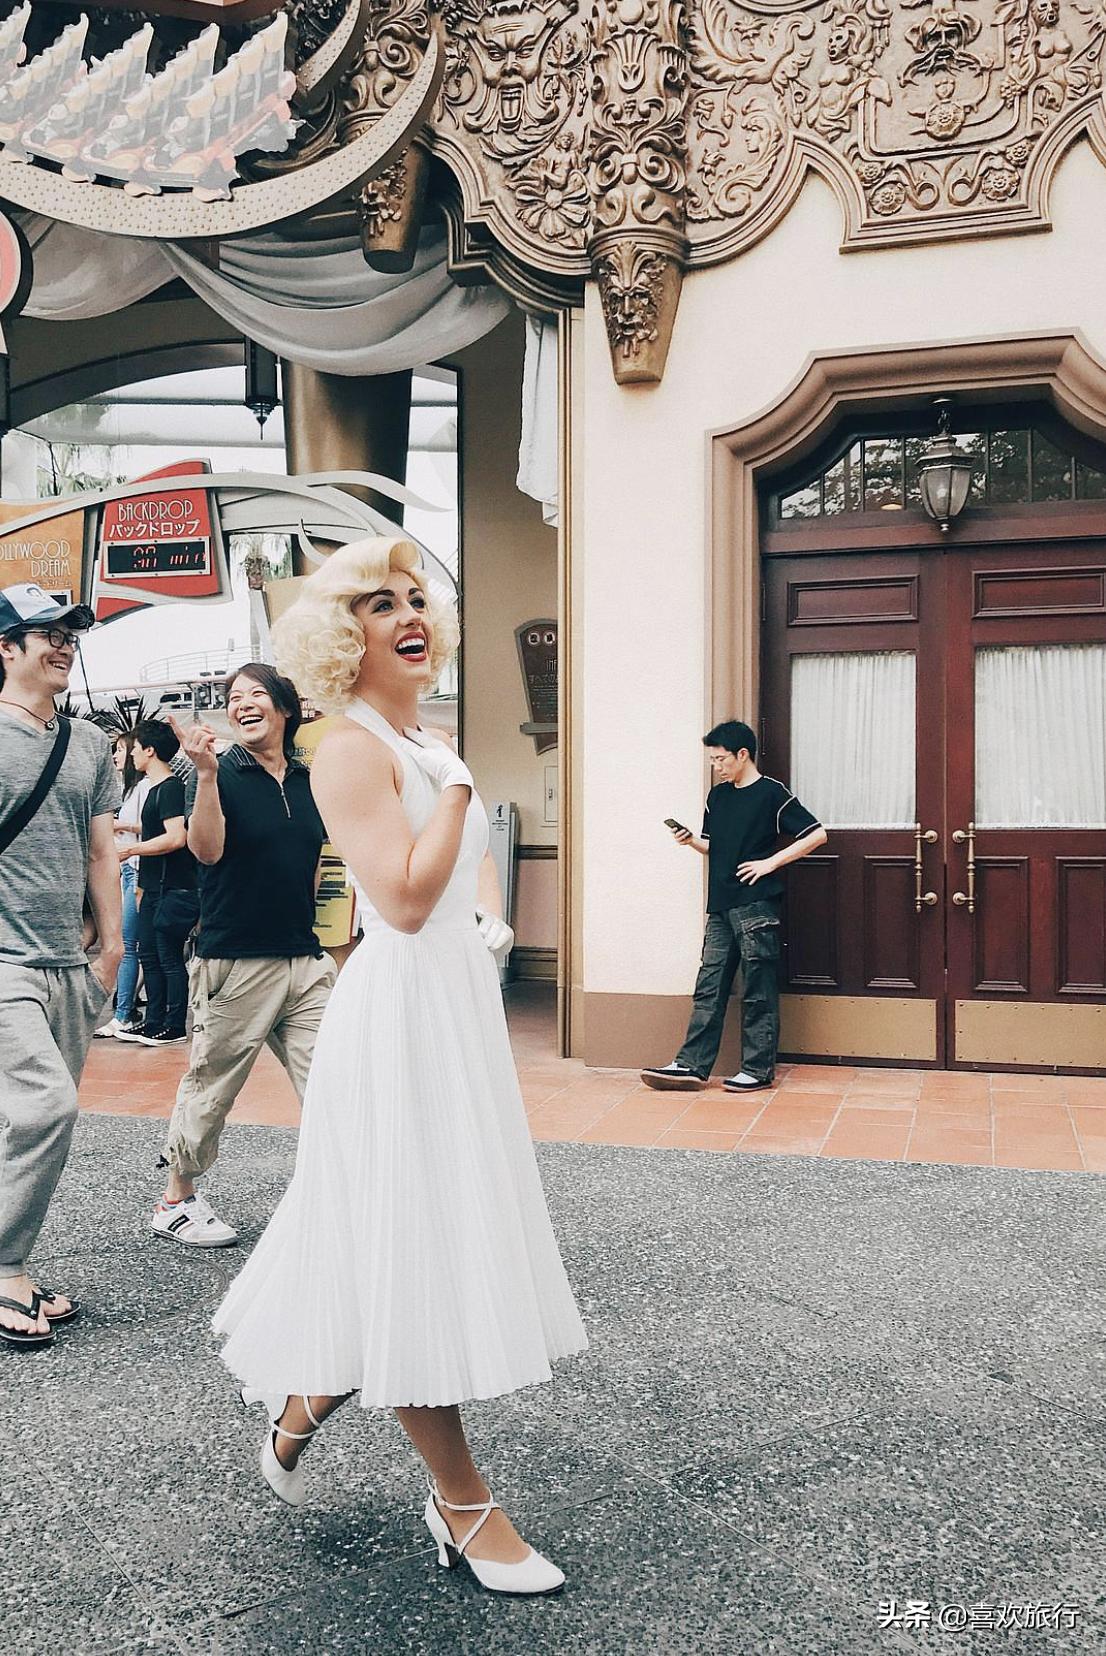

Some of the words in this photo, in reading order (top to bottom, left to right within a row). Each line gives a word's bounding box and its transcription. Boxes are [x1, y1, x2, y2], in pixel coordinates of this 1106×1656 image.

[118, 500, 193, 522] BACKDROP
[109, 519, 200, 538] バックドロップ
[31, 559, 71, 578] DREAM
